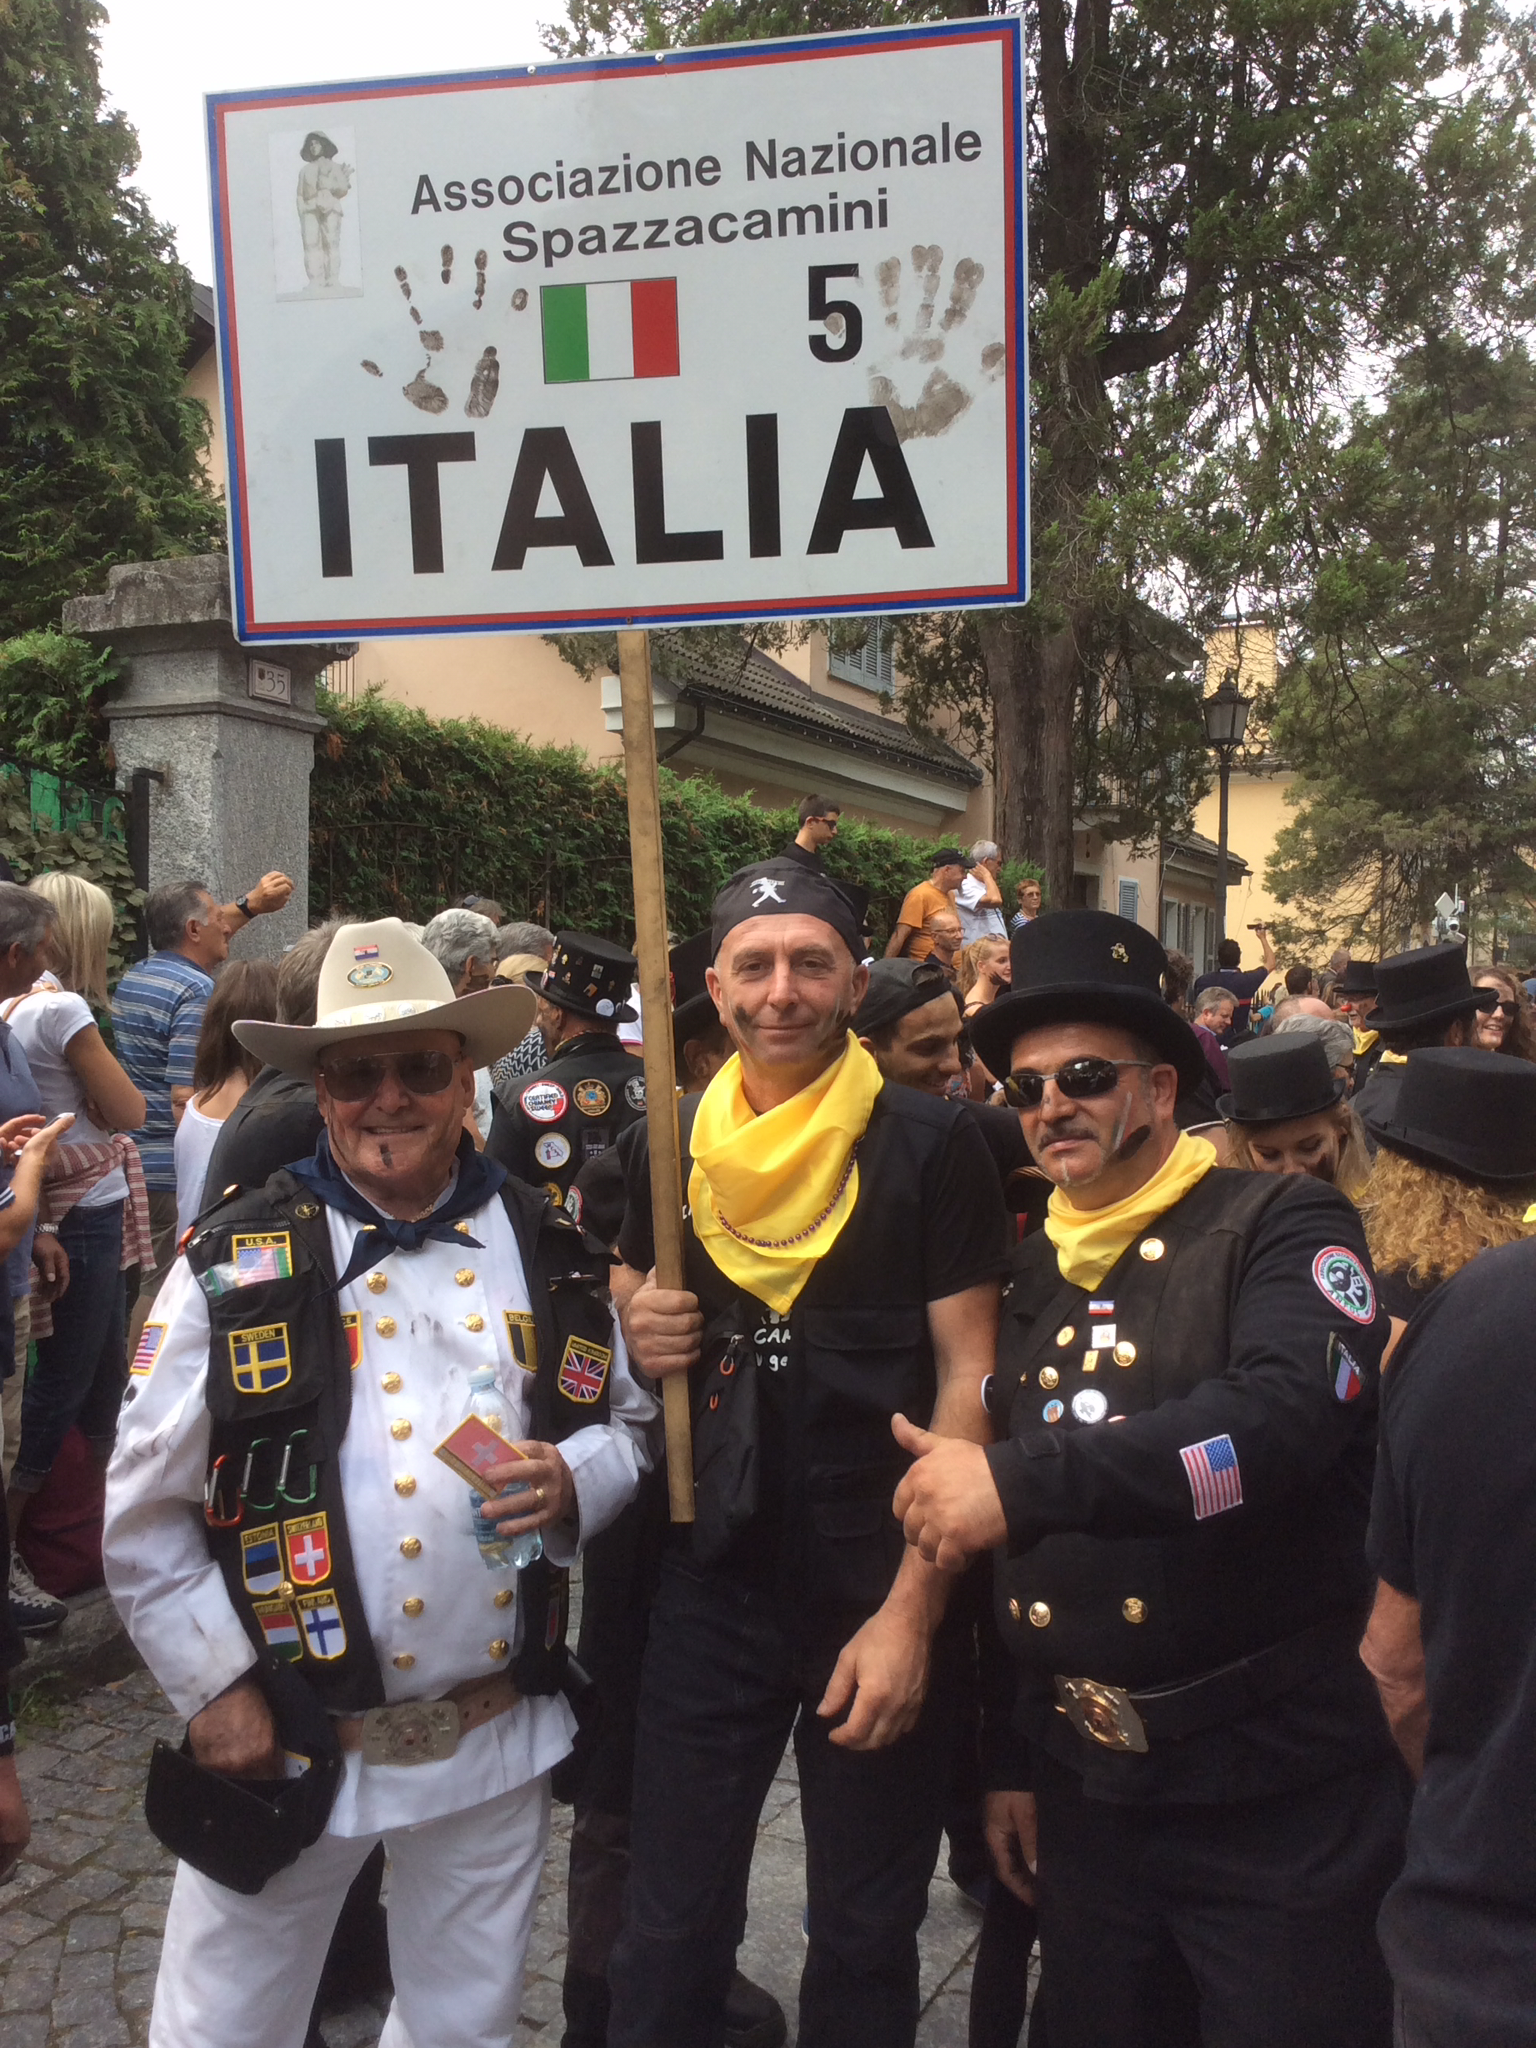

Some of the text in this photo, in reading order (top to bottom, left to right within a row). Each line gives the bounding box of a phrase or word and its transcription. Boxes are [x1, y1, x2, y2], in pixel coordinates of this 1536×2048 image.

[412, 121, 982, 215] Associazione Nazionale
[502, 188, 890, 264] Spazzacamini
[807, 262, 863, 363] 5
[314, 405, 936, 578] ITALIA
[266, 670, 286, 695] 35
[245, 1236, 277, 1246] U.S.A.
[241, 1328, 275, 1342] SWEDEN
[1338, 1341, 1360, 1376] ITALIA
